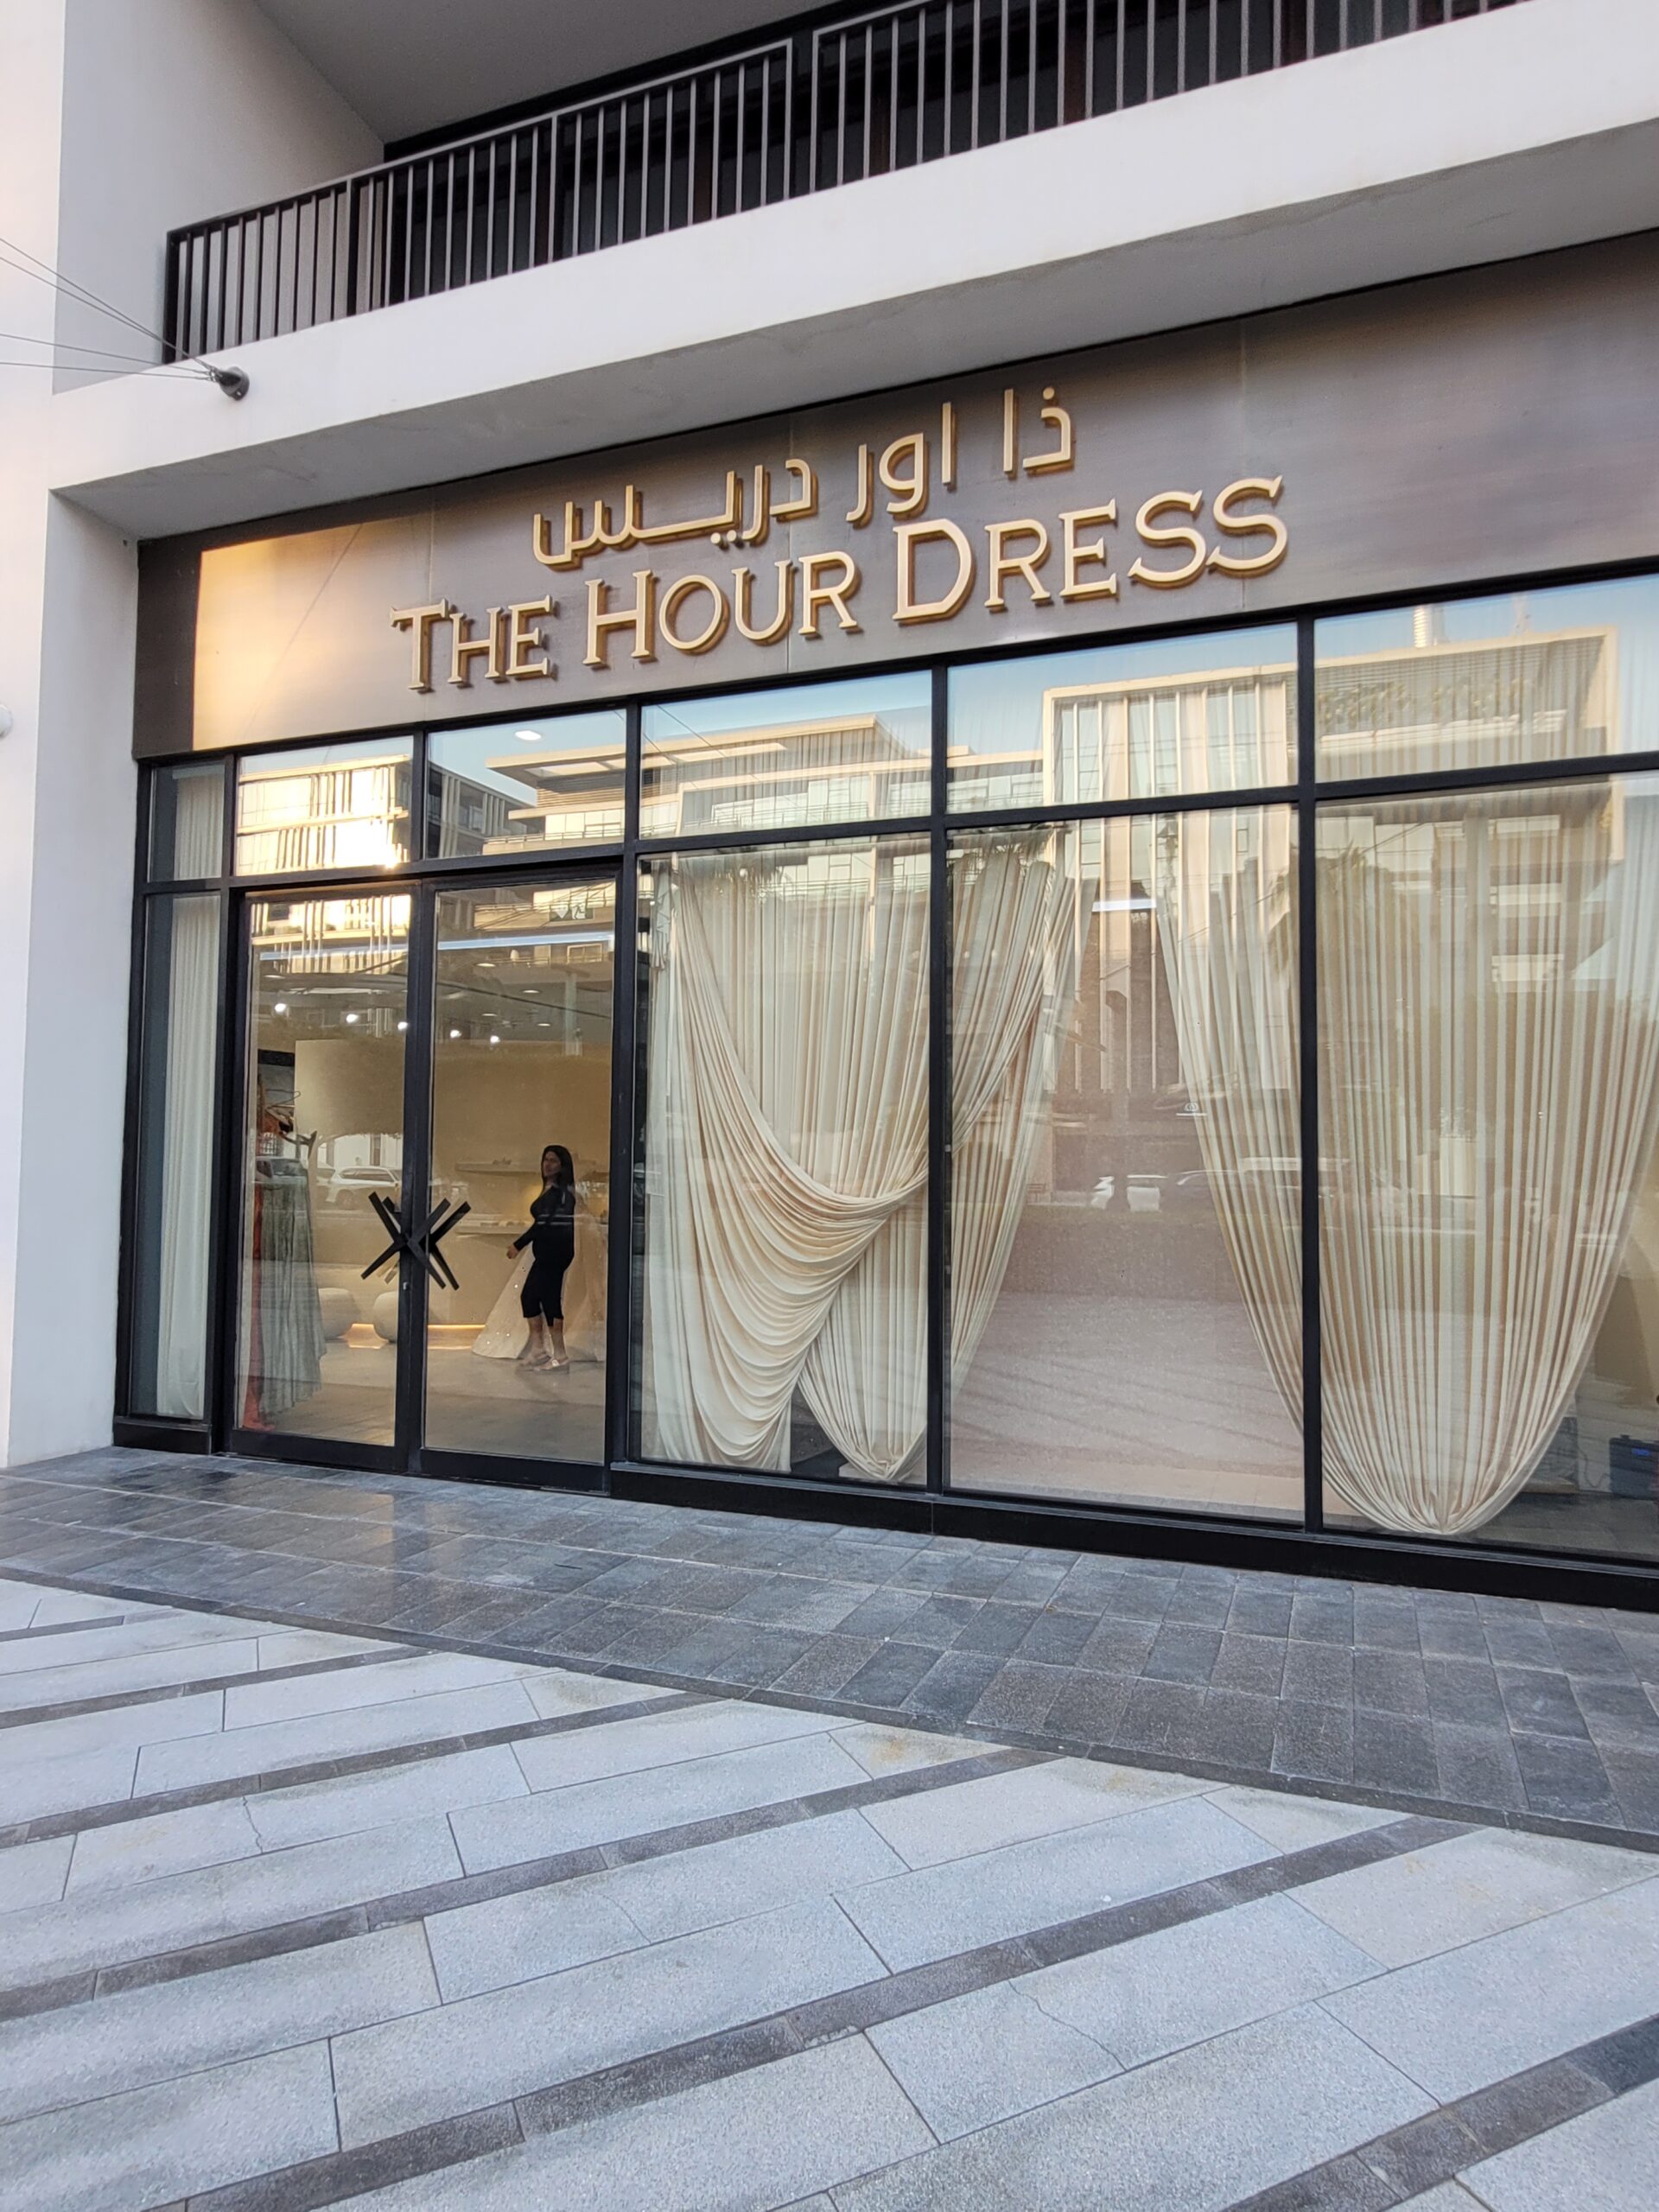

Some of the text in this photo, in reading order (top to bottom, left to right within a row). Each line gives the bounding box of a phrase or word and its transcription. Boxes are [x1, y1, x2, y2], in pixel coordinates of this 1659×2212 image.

[846, 401, 951, 522] اور
[1003, 386, 1072, 474] ذا
[389, 474, 1288, 690] THE HOUR DRESS
